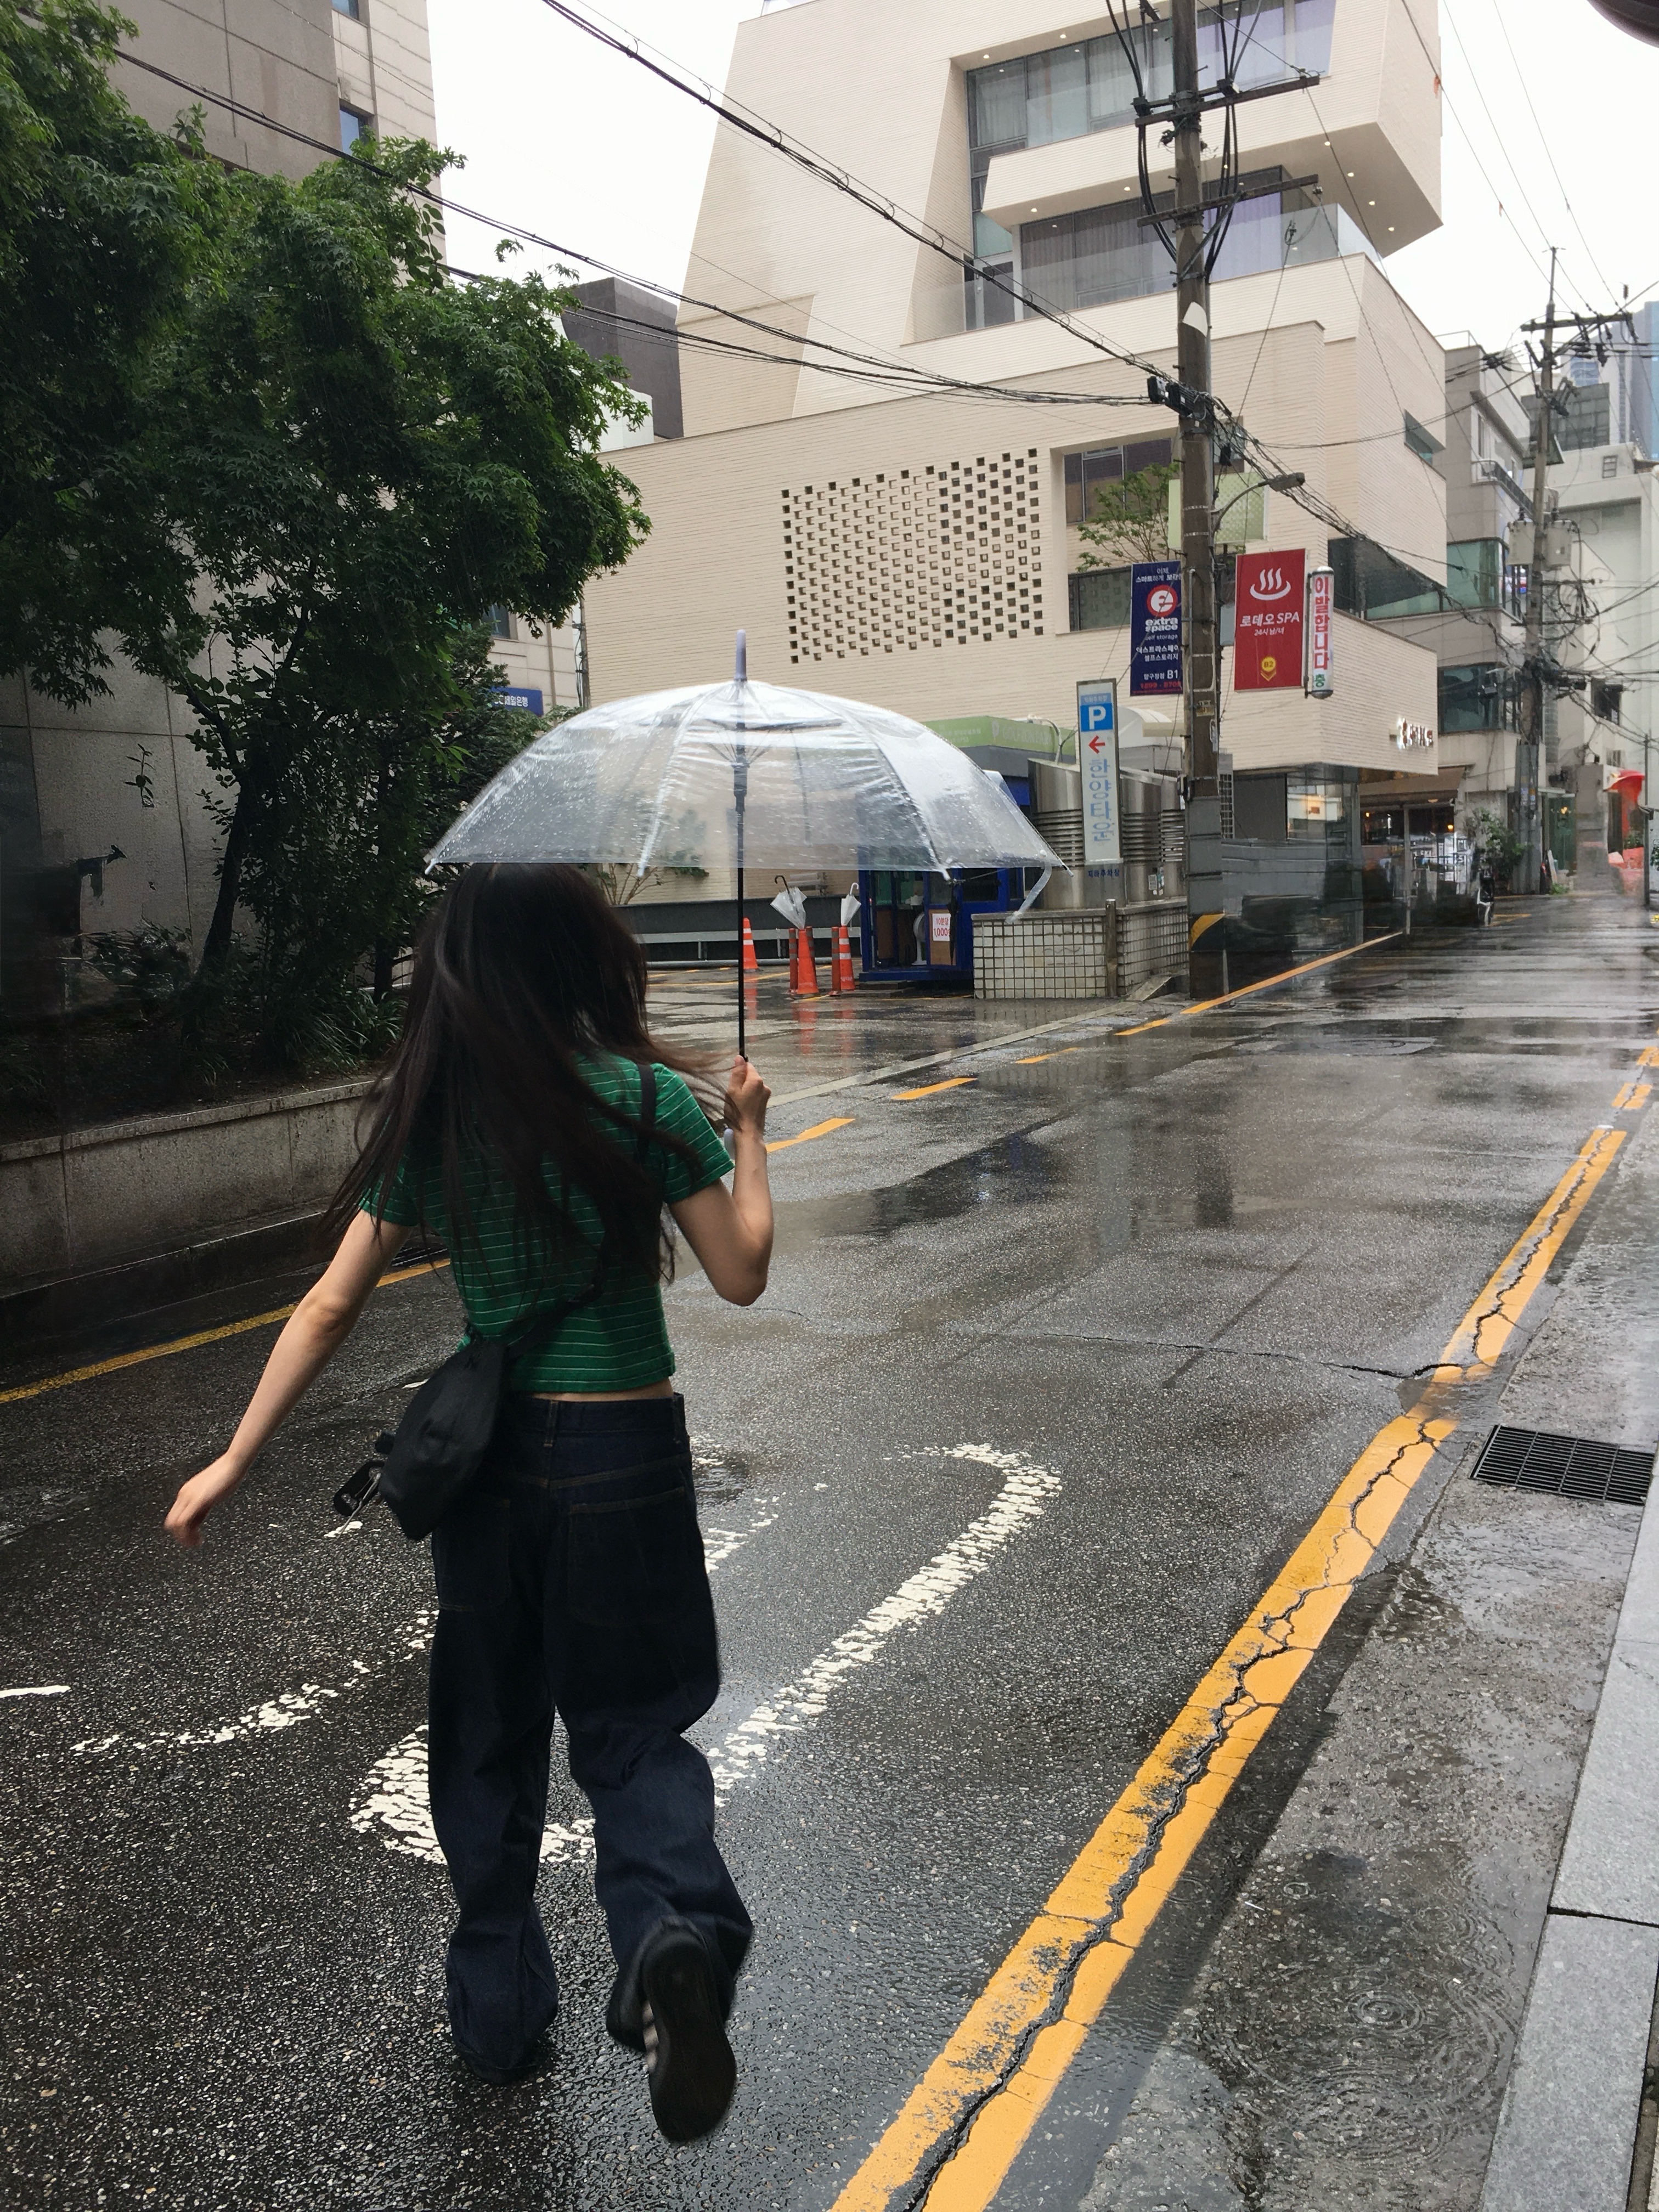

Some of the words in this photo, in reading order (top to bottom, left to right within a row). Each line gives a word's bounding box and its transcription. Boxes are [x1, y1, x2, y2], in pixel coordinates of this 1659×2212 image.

[1146, 617, 1178, 626] extra
[1240, 613, 1274, 627] 로데오
[1277, 612, 1300, 624] SPA
[1314, 577, 1330, 670] 이발합니다
[1146, 624, 1178, 633] space
[1167, 669, 1178, 679] B1
[1088, 706, 1106, 730] P
[1089, 759, 1114, 842] 한양타운
[934, 928, 950, 937] 1,000
